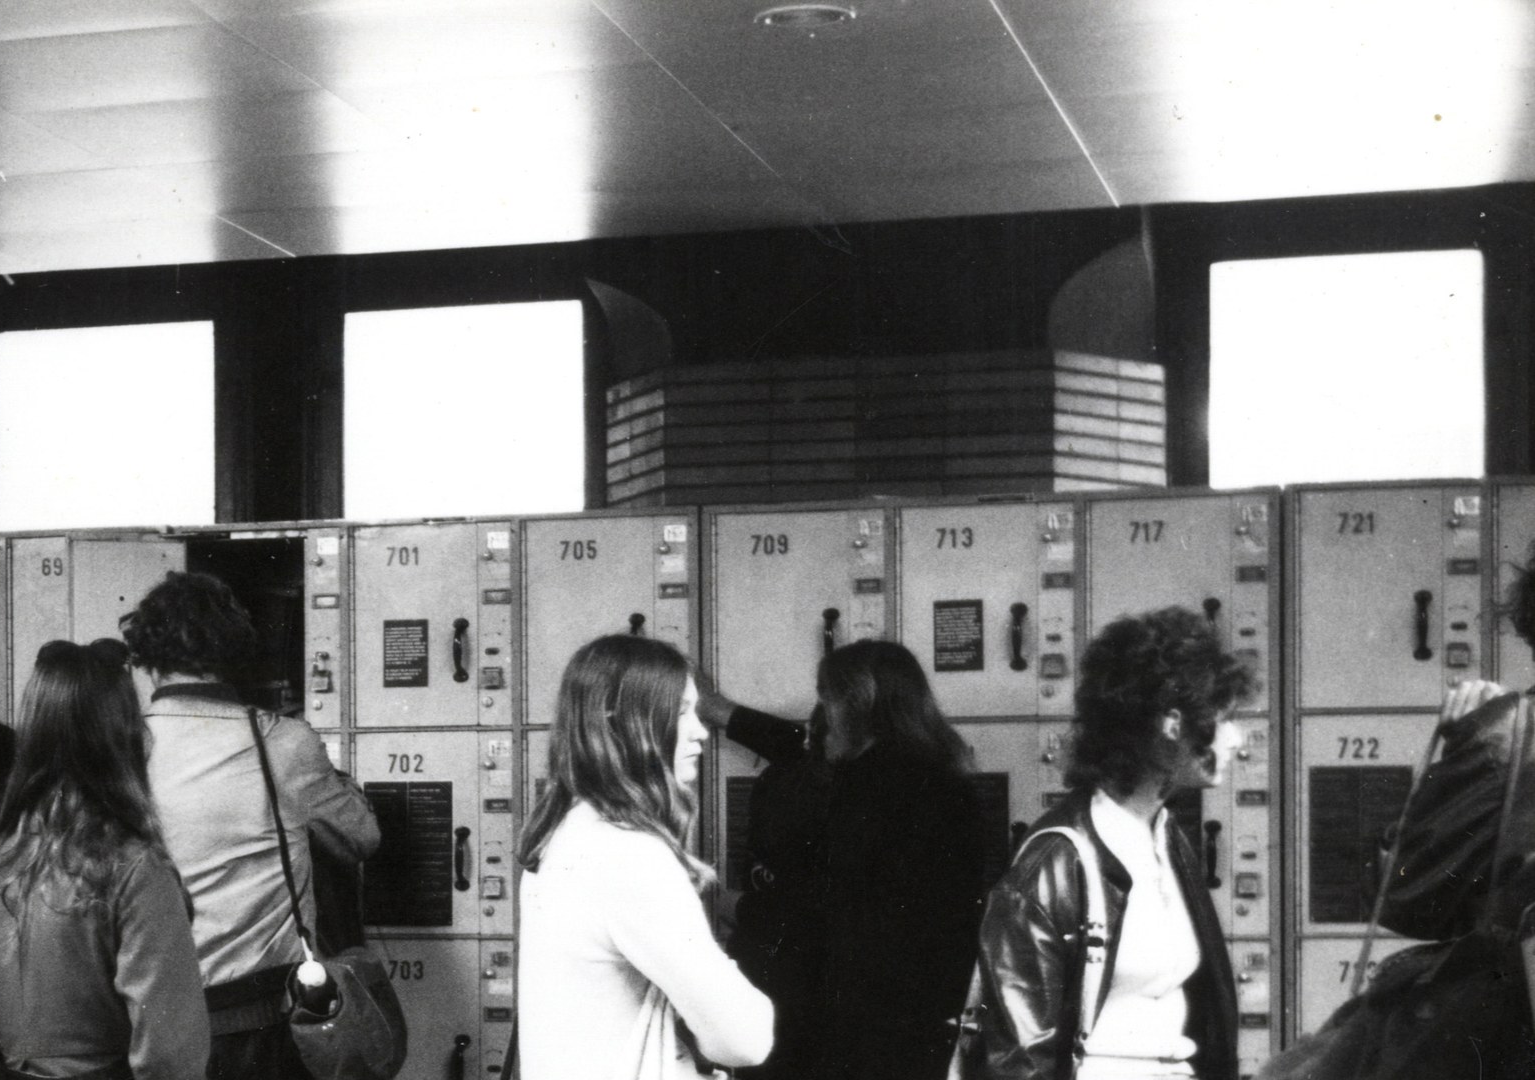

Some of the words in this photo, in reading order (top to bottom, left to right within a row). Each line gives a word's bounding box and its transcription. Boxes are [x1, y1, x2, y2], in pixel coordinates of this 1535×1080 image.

[1129, 520, 1164, 543] 717
[1338, 512, 1375, 534] 721
[751, 534, 788, 555] 709
[936, 527, 973, 549] 713
[387, 546, 419, 566] 701
[560, 540, 597, 561] 705
[42, 557, 63, 576] 69
[1337, 737, 1380, 760] 722
[388, 753, 424, 774] 702
[389, 960, 424, 980] 703
